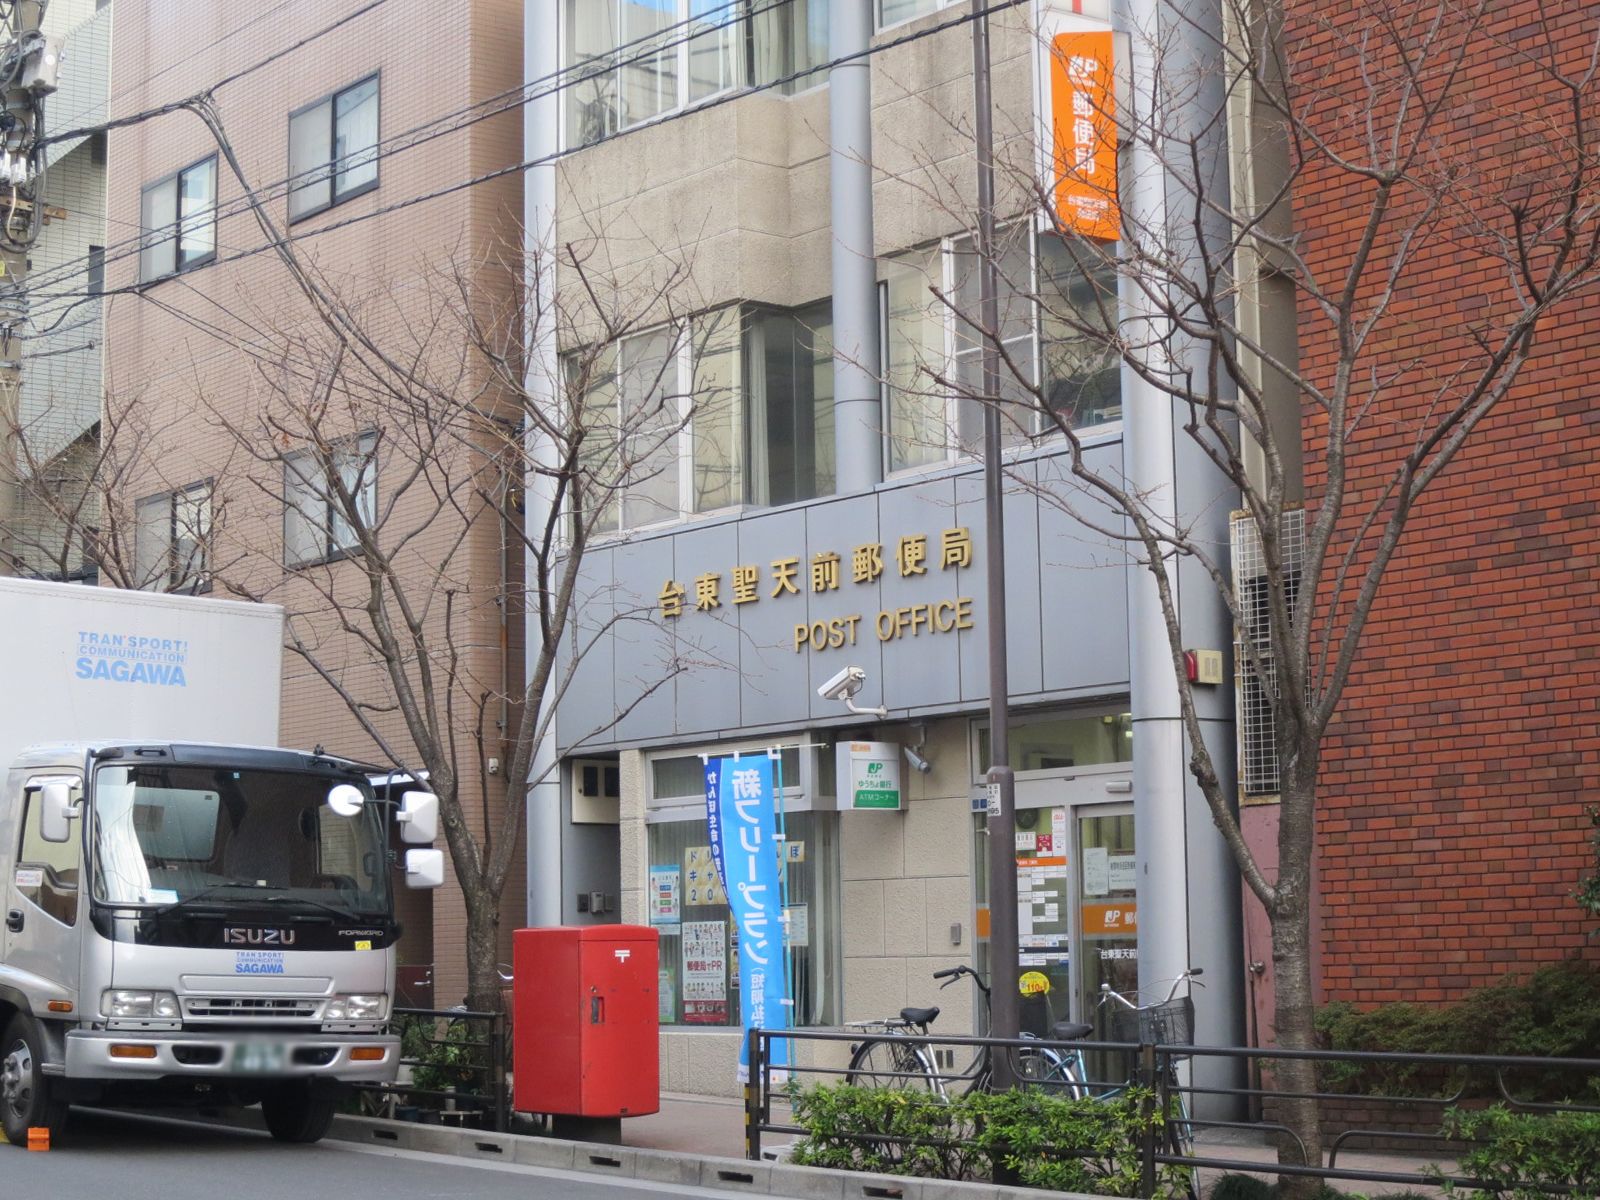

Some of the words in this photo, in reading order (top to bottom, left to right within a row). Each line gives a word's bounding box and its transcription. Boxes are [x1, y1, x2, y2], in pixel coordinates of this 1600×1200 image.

[1072, 90, 1096, 175] 郵便局
[657, 526, 973, 619] 台東聖天前郵便局
[794, 614, 863, 654] POST
[876, 597, 974, 642] OFFICE
[79, 645, 185, 664] COMMUNICATION
[75, 656, 187, 687] SAGAWA
[858, 780, 893, 789] ゆうちょ銀行
[223, 927, 296, 945] ISUZU
[235, 963, 284, 974] SAGAWA
